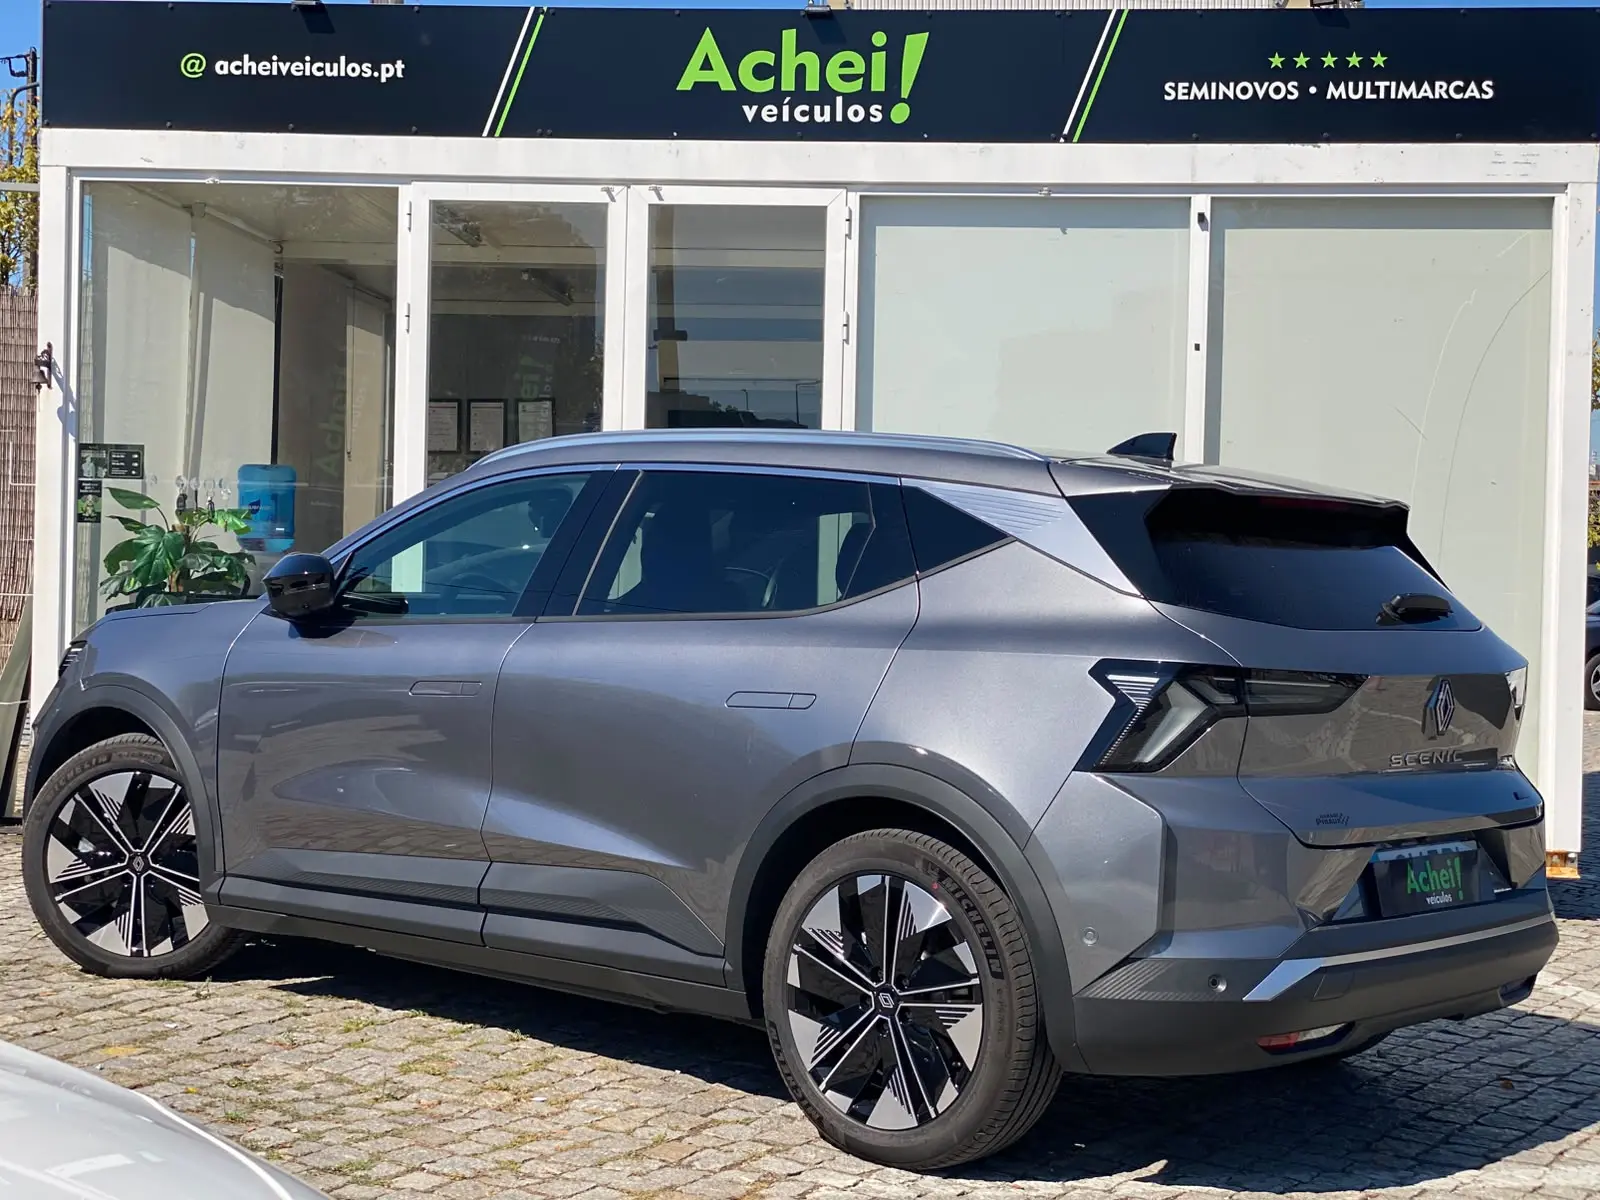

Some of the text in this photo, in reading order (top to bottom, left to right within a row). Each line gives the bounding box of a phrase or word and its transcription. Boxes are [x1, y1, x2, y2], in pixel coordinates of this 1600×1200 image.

[215, 54, 405, 82] acheiveiculos.pt
[676, 27, 929, 123] Achei!
[1164, 81, 1494, 100] SEMINOVOS MULTIMARCAS
[742, 96, 883, 122] veículos
[1390, 749, 1462, 767] SCENIC
[1407, 856, 1463, 901] Achei!
[941, 877, 1004, 976] MICHELIN
